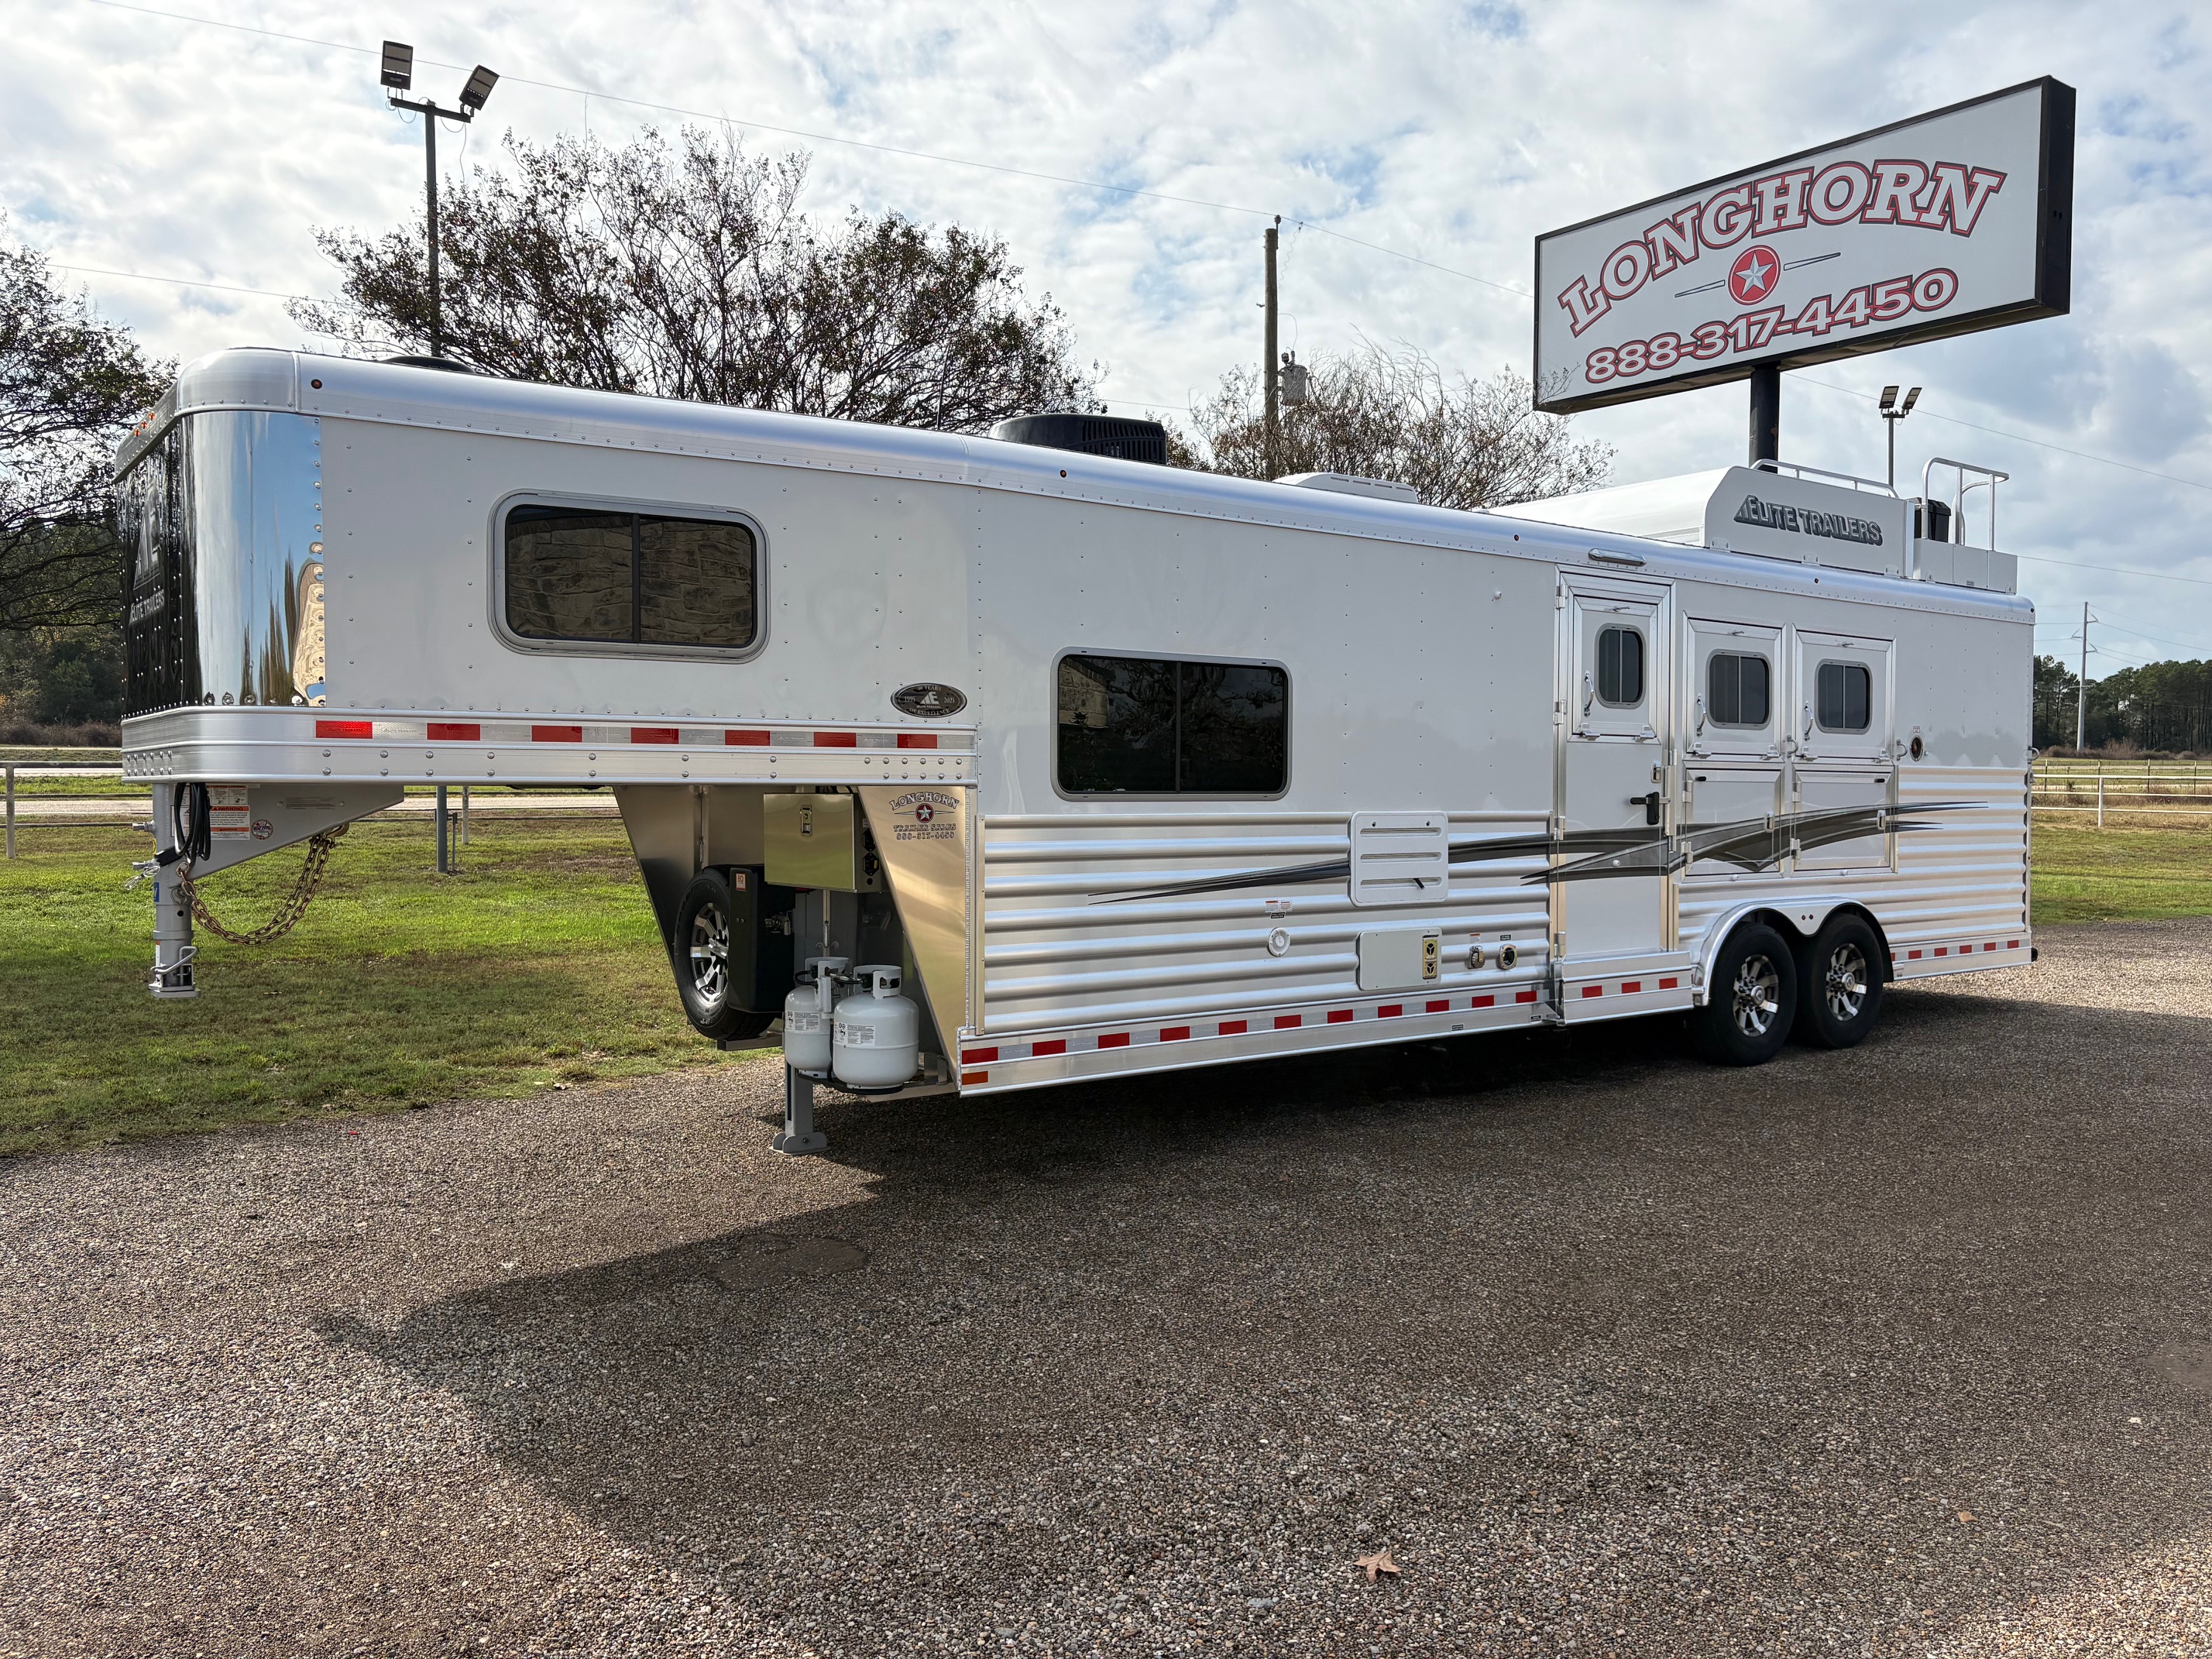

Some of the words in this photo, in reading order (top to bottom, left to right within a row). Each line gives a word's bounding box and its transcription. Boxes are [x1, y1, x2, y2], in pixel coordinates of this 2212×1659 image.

[1558, 160, 2008, 338] LONGHORN
[1585, 268, 1959, 383] 888-317-4450
[1733, 495, 1801, 533] ELITE
[1798, 508, 1884, 547] TRAILERS
[889, 792, 960, 811] LONGHORN
[930, 823, 957, 831] SALES
